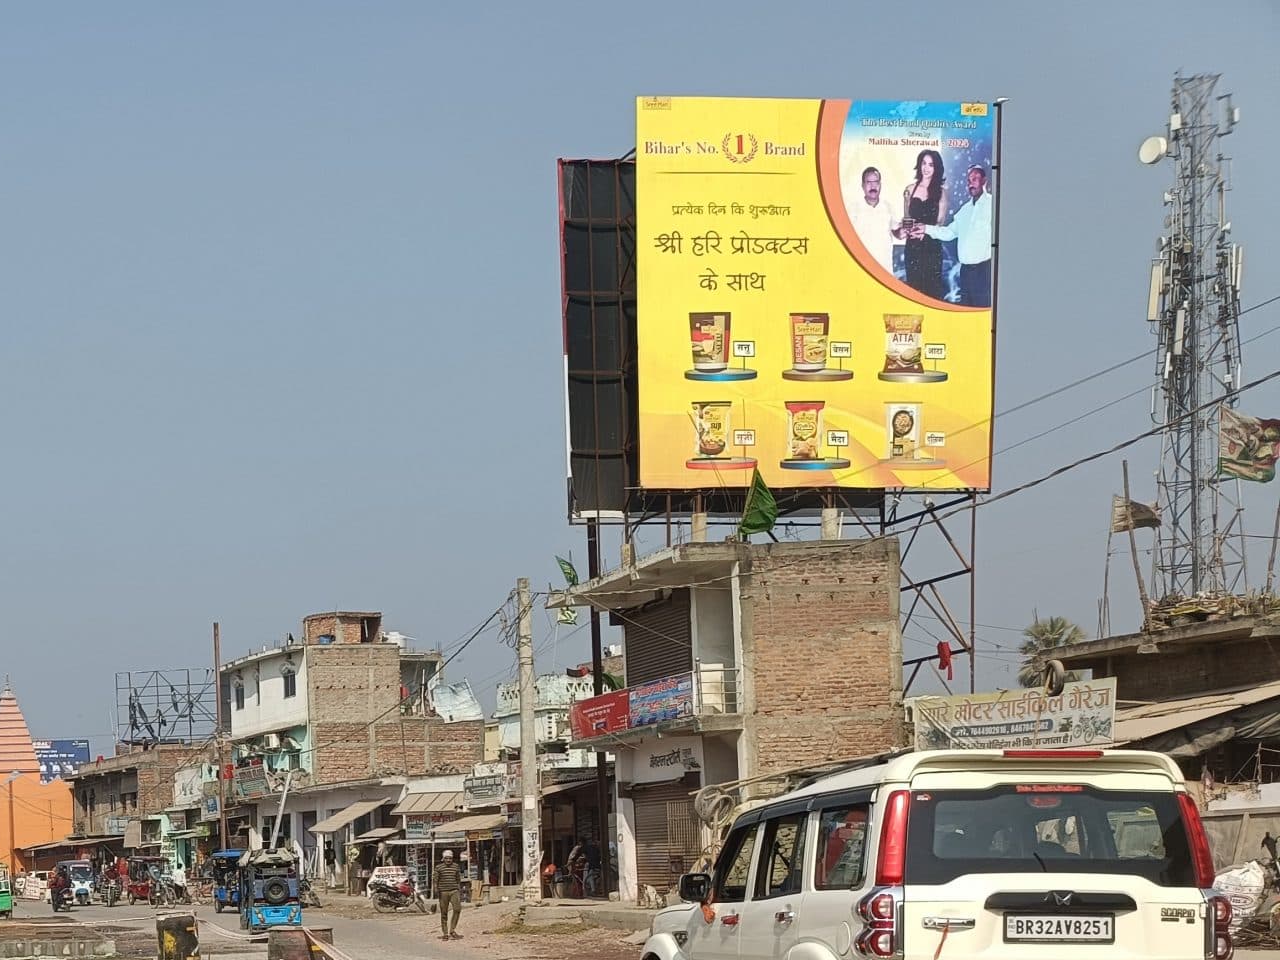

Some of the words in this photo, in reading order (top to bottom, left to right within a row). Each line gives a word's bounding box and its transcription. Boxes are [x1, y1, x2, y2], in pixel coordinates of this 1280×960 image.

[644, 141, 692, 154] Bihar's
[696, 142, 719, 154] No.
[735, 135, 745, 155] 1
[764, 142, 805, 156] Brand
[672, 202, 704, 216] प्रत्येक
[708, 202, 726, 216] दिन
[731, 202, 745, 216] कि
[654, 230, 683, 254] श्री
[691, 230, 722, 256] हरि
[698, 267, 719, 291] के
[725, 272, 766, 291] साथ
[892, 334, 914, 343] ATTA
[954, 698, 994, 722] मोटर
[1069, 684, 1112, 711] गैरेज
[1161, 907, 1196, 918] SCORPIO
[1016, 919, 1110, 936] BR32AV8251
